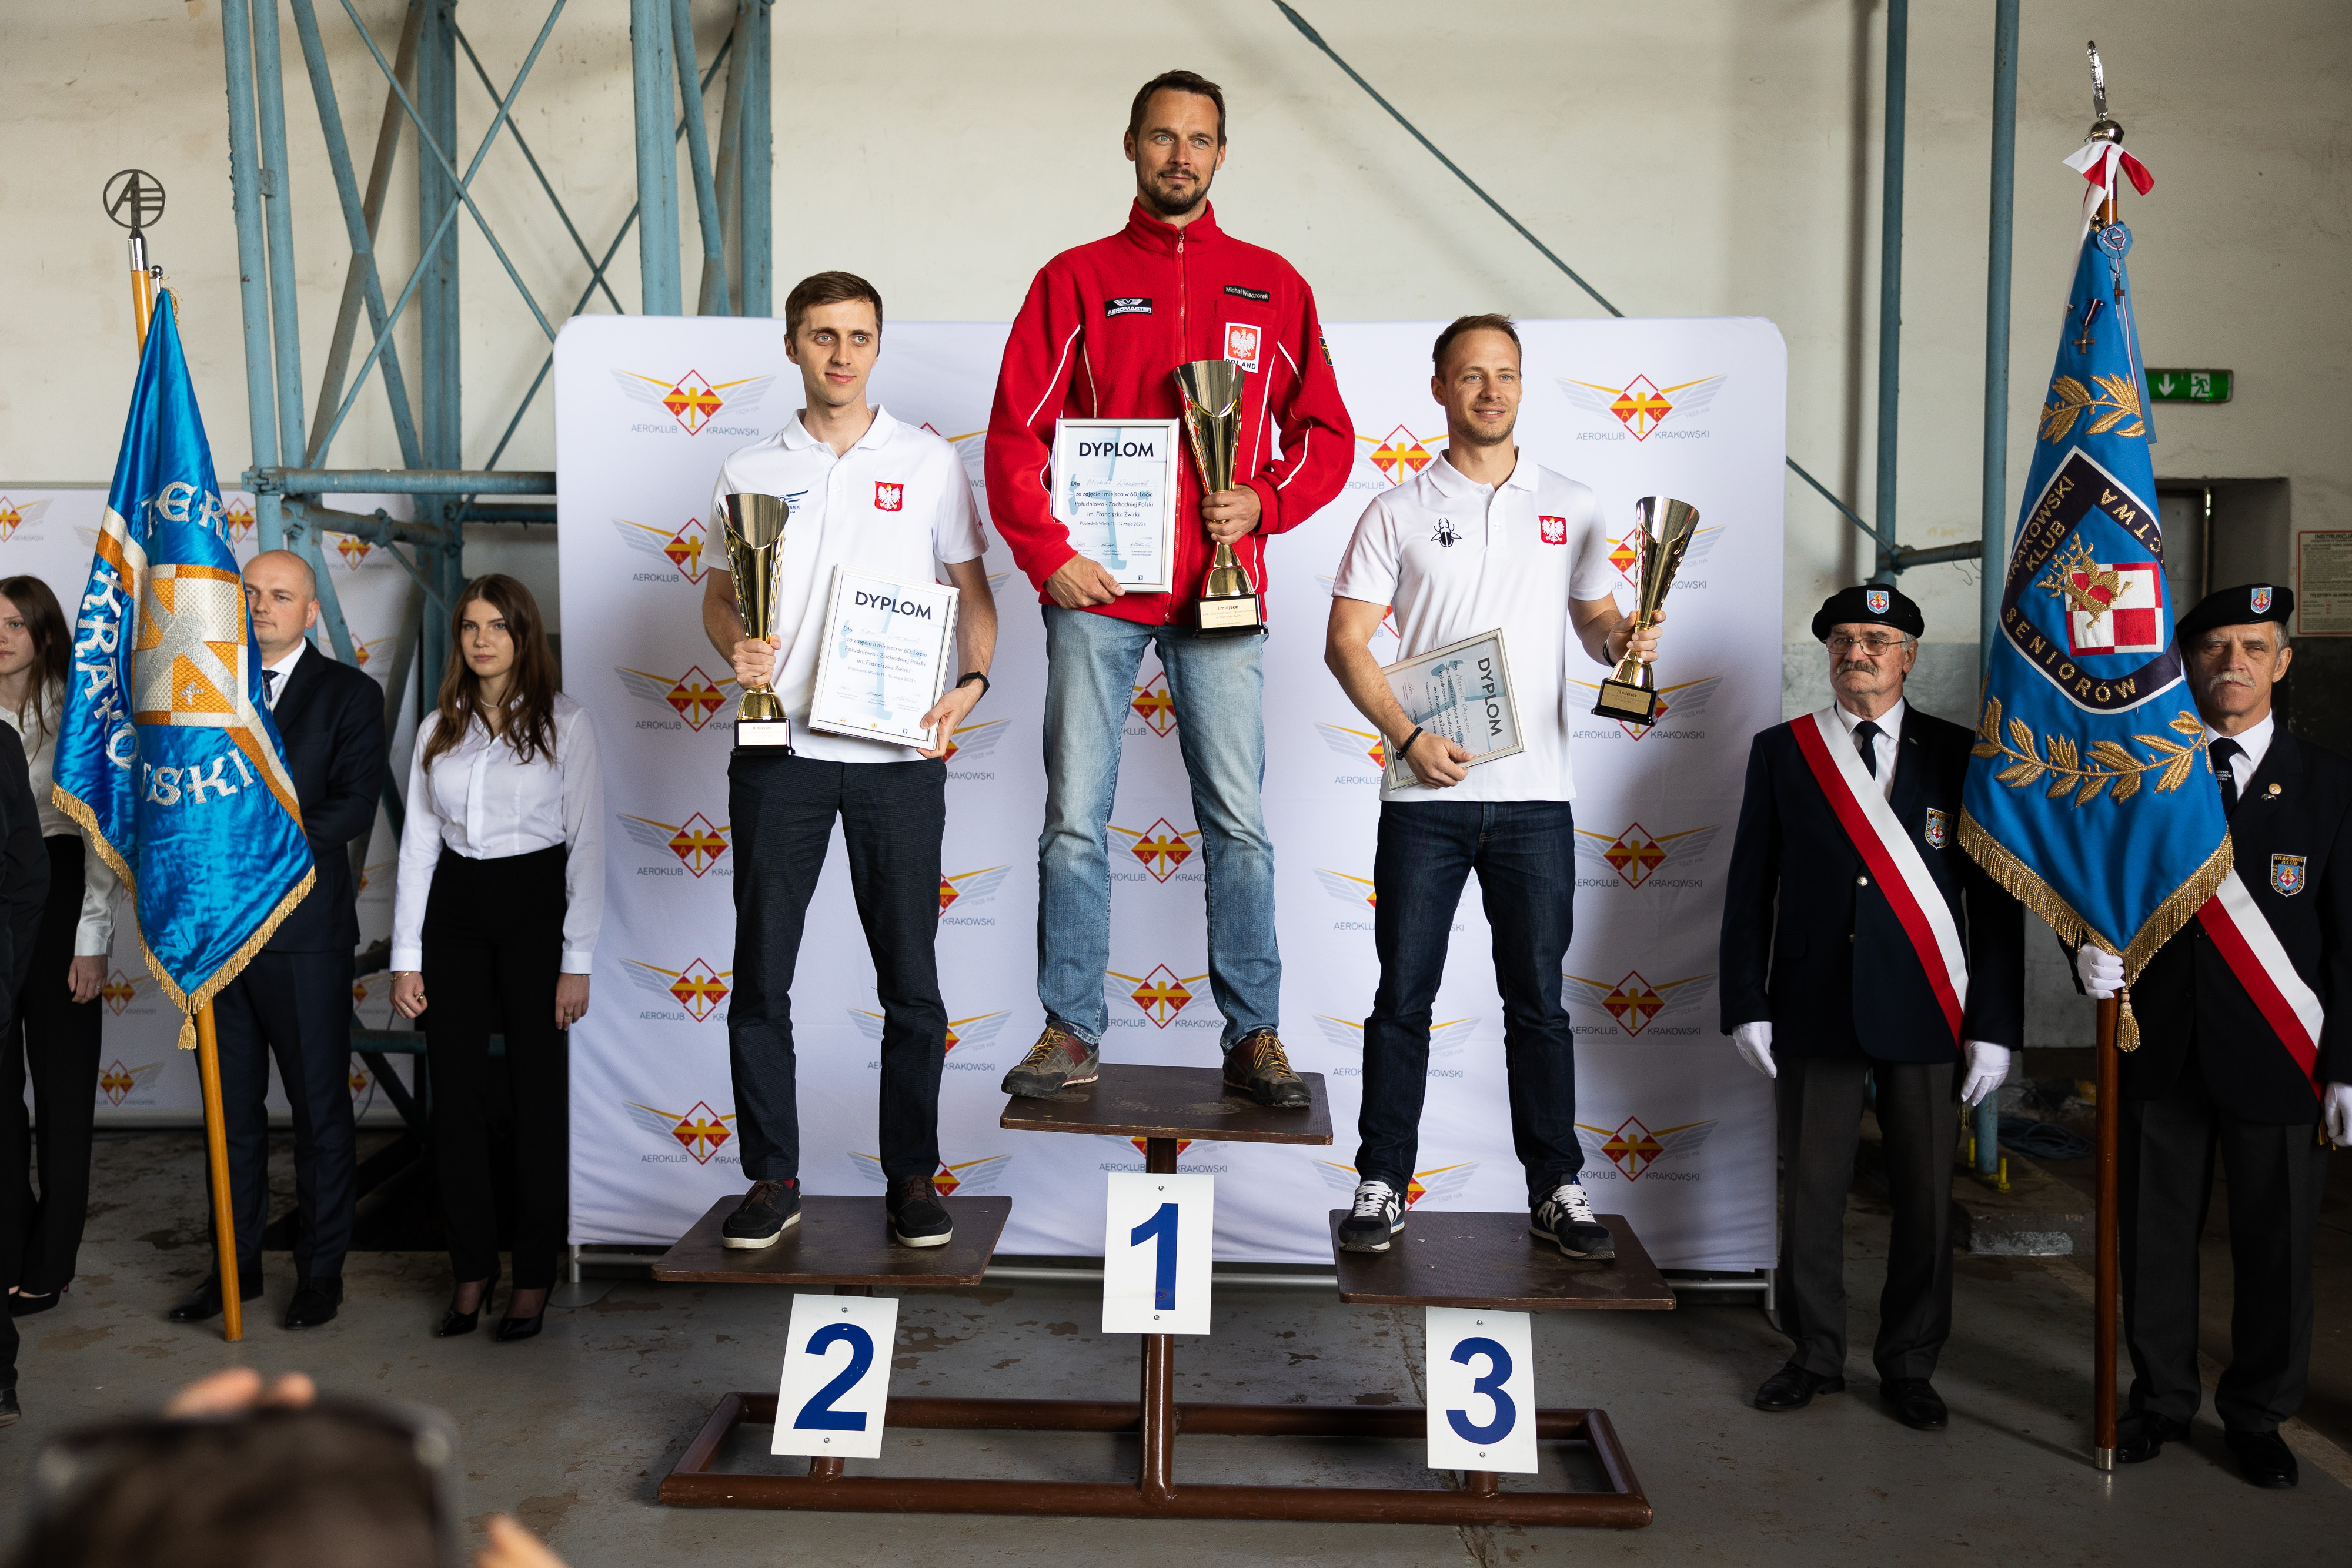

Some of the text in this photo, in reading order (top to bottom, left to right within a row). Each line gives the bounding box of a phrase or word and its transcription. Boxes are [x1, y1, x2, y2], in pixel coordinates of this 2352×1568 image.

[1225, 286, 1242, 295] Michał
[1107, 306, 1152, 317] AEROMASTER
[674, 403, 713, 414] A K
[1621, 409, 1662, 419] A K
[631, 424, 759, 436] AEROKLUB KRAKOWSKI
[1576, 430, 1709, 440] AEROKLUB KRAKOWSKI
[1079, 442, 1154, 457] DYPLOM
[1381, 459, 1421, 469] A K
[1344, 482, 1385, 490] EROKLUB
[2025, 520, 2066, 572] KLUB
[674, 553, 683, 561] A
[1619, 560, 1628, 569] A
[633, 573, 679, 583] AEROKLUB
[1672, 581, 1707, 589] KOWSKI
[855, 591, 931, 620] DYPLOM
[854, 638, 872, 647] zajęcie
[877, 643, 897, 651] miejsca
[845, 646, 876, 657] Południowo
[880, 653, 910, 665] Zachodniej
[2006, 607, 2136, 703] SENIORÓW
[866, 660, 894, 670] Franciszka
[894, 665, 911, 674] Żwirki
[1439, 671, 1447, 701] Południowo
[180, 681, 204, 706] K
[1478, 657, 1503, 737] DYPLOM
[635, 721, 682, 730] AEROKLUB
[1573, 731, 1705, 740] AEROKLUB KRAKOWSKI
[946, 772, 995, 780] RAKOWSKI
[1335, 776, 1382, 785] AEROKLUB
[1142, 852, 1182, 861] A K
[637, 867, 683, 876] AEROKLUB
[1111, 873, 1205, 882] ROKLUB KRAKO
[2290, 867, 2303, 894] LOTNICTWA
[1649, 880, 1703, 888] KRAKOWSKI
[941, 896, 948, 905] K
[943, 918, 995, 926] KRAKOWSKI
[1334, 922, 1375, 931] AEROKLU
[680, 992, 719, 1001] A K
[1142, 998, 1182, 1007] A K
[640, 1011, 685, 1021] AEROKLUB
[1108, 1019, 1225, 1028] EROKLUB KRAKOWSK
[1647, 1027, 1700, 1035] KRAKOWSKI
[943, 1062, 995, 1071] KRAKOWSKI
[1333, 1068, 1463, 1078] AEROK KOWSKI
[642, 1155, 687, 1163] AEROKLUB
[1099, 1163, 1228, 1174] AEROKLUB KRAKOWSKI
[1576, 1171, 1700, 1181] EROKLUB KRAKOWSKI
[1131, 1204, 1178, 1310] 1
[794, 1323, 874, 1431] 2
[1446, 1338, 1516, 1445] 3
